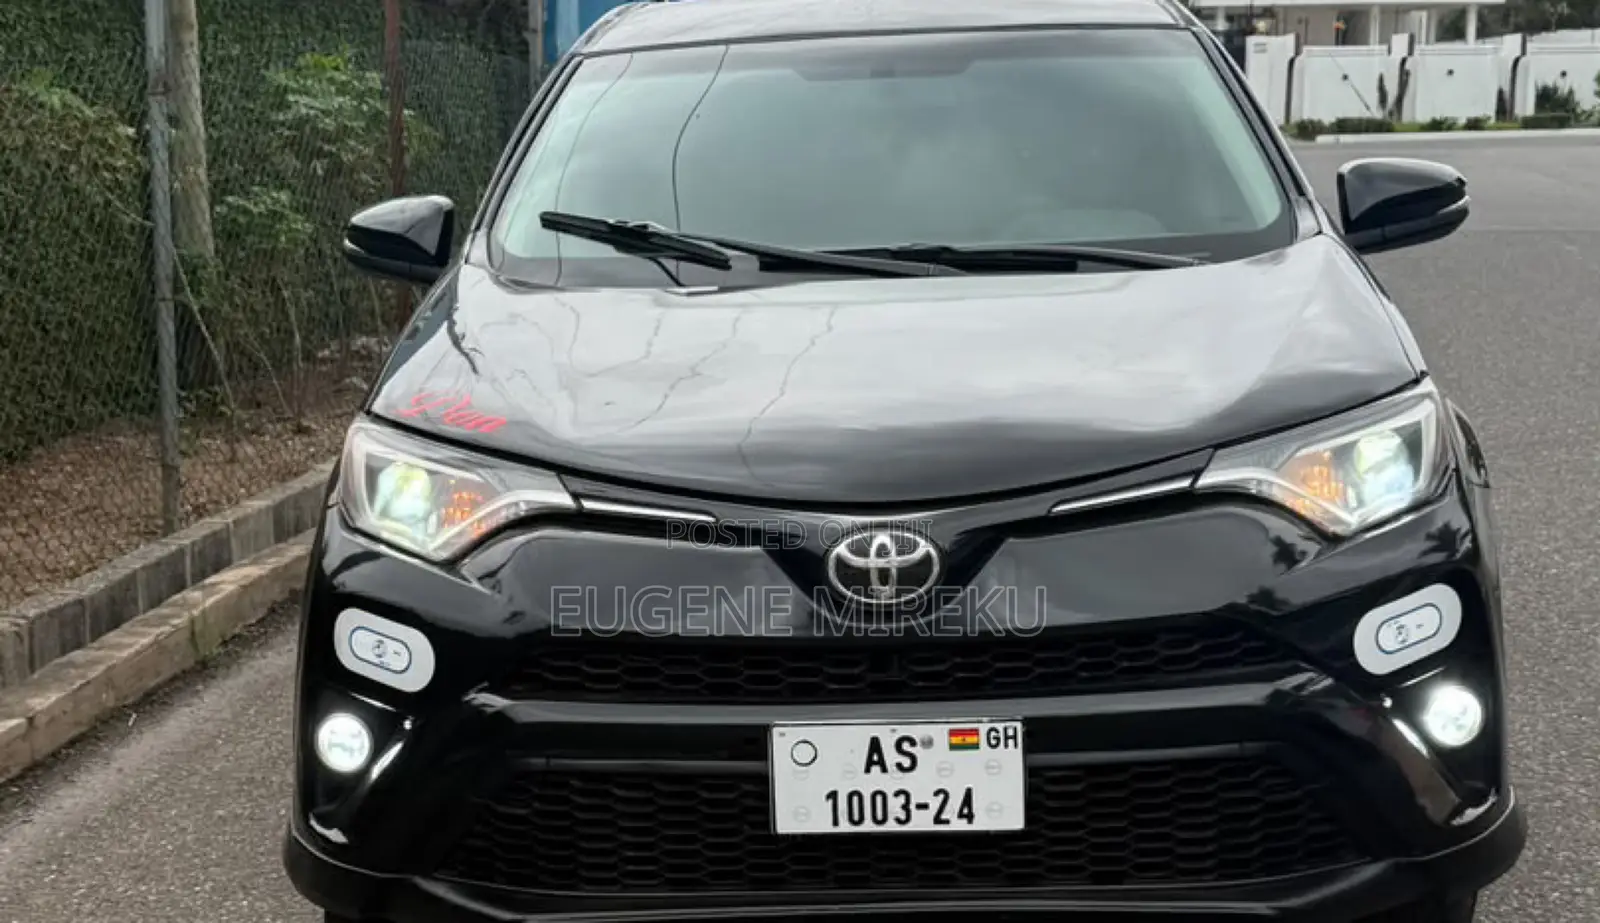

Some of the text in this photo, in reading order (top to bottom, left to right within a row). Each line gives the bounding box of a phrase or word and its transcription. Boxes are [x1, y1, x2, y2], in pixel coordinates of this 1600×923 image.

[863, 735, 919, 774] AS
[985, 726, 1019, 750] GH
[824, 786, 976, 828] 1003-24
